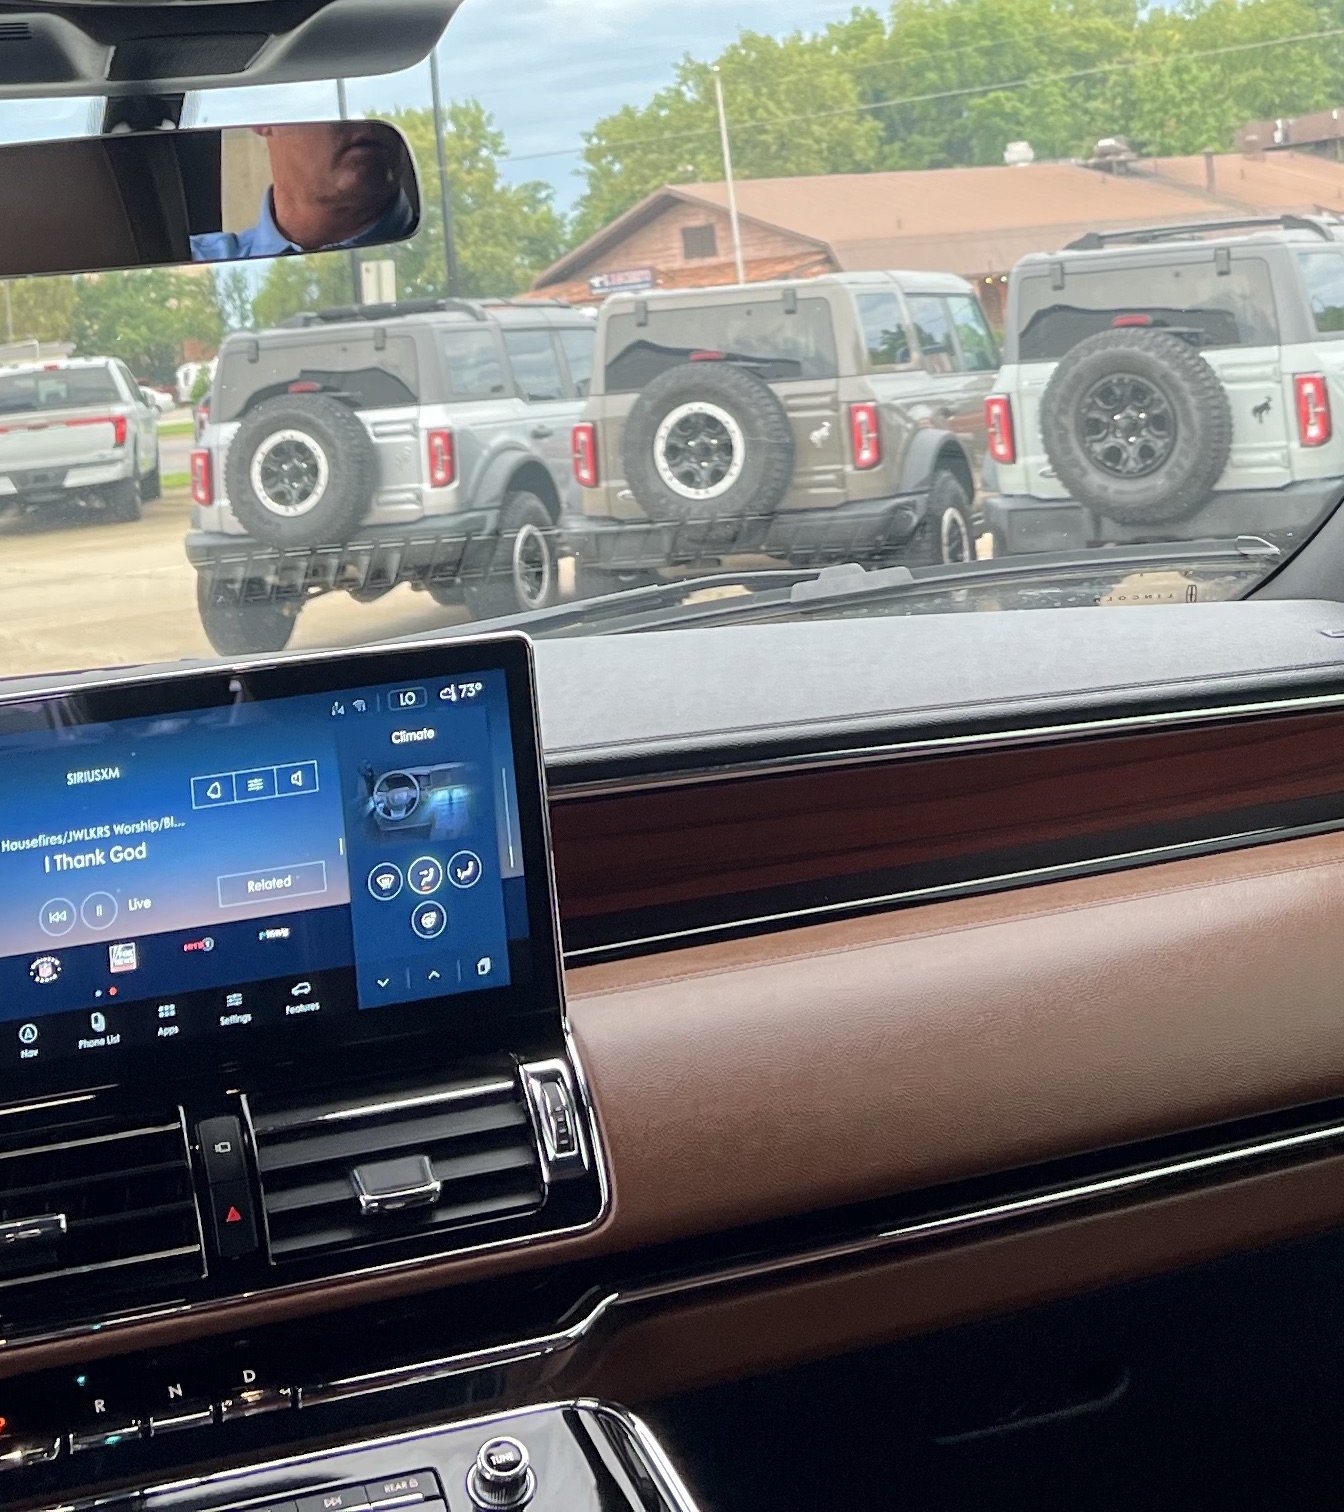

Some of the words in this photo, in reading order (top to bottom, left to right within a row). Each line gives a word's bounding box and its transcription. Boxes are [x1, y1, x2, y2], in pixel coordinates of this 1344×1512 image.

[400, 691, 416, 706] LO
[391, 727, 435, 744] Climate
[66, 766, 120, 786] SIRIUSXM
[0, 824, 111, 852] Housefires/JWLKRS
[44, 855, 50, 873] I
[54, 848, 105, 872] Thank
[110, 841, 147, 863] God
[247, 875, 292, 893] Related
[128, 897, 152, 912] Live
[285, 1001, 321, 1016] Features
[219, 1012, 253, 1026] Settings
[157, 1025, 179, 1037] Apps
[78, 1037, 106, 1050] Phone
[106, 1034, 121, 1046] List
[95, 1399, 106, 1413] R
[168, 1384, 183, 1399] N
[243, 1369, 256, 1383] D
[490, 1451, 515, 1467] TUNE
[383, 1481, 407, 1494] REAR
